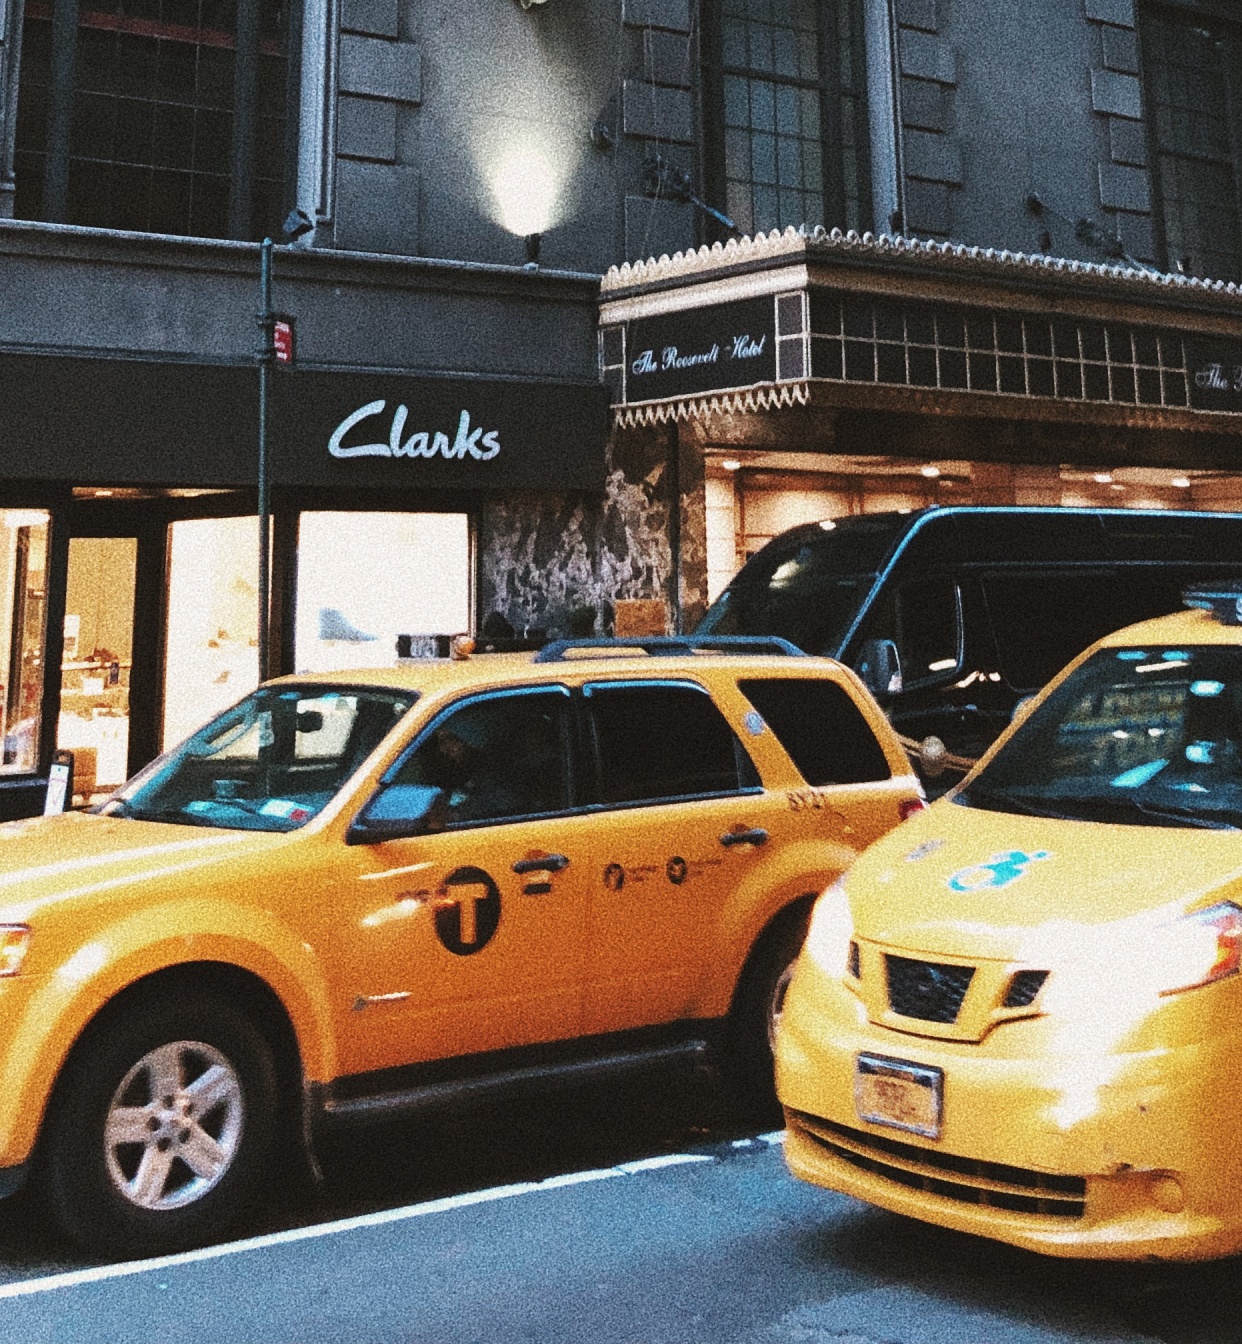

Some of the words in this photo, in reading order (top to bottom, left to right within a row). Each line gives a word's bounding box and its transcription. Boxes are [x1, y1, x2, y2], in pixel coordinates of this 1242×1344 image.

[632, 350, 658, 375] The
[662, 343, 719, 370] Roosevelt
[723, 333, 766, 360] Hotel
[1195, 362, 1229, 390] The
[328, 399, 500, 460] Clarks
[447, 882, 490, 946] T
